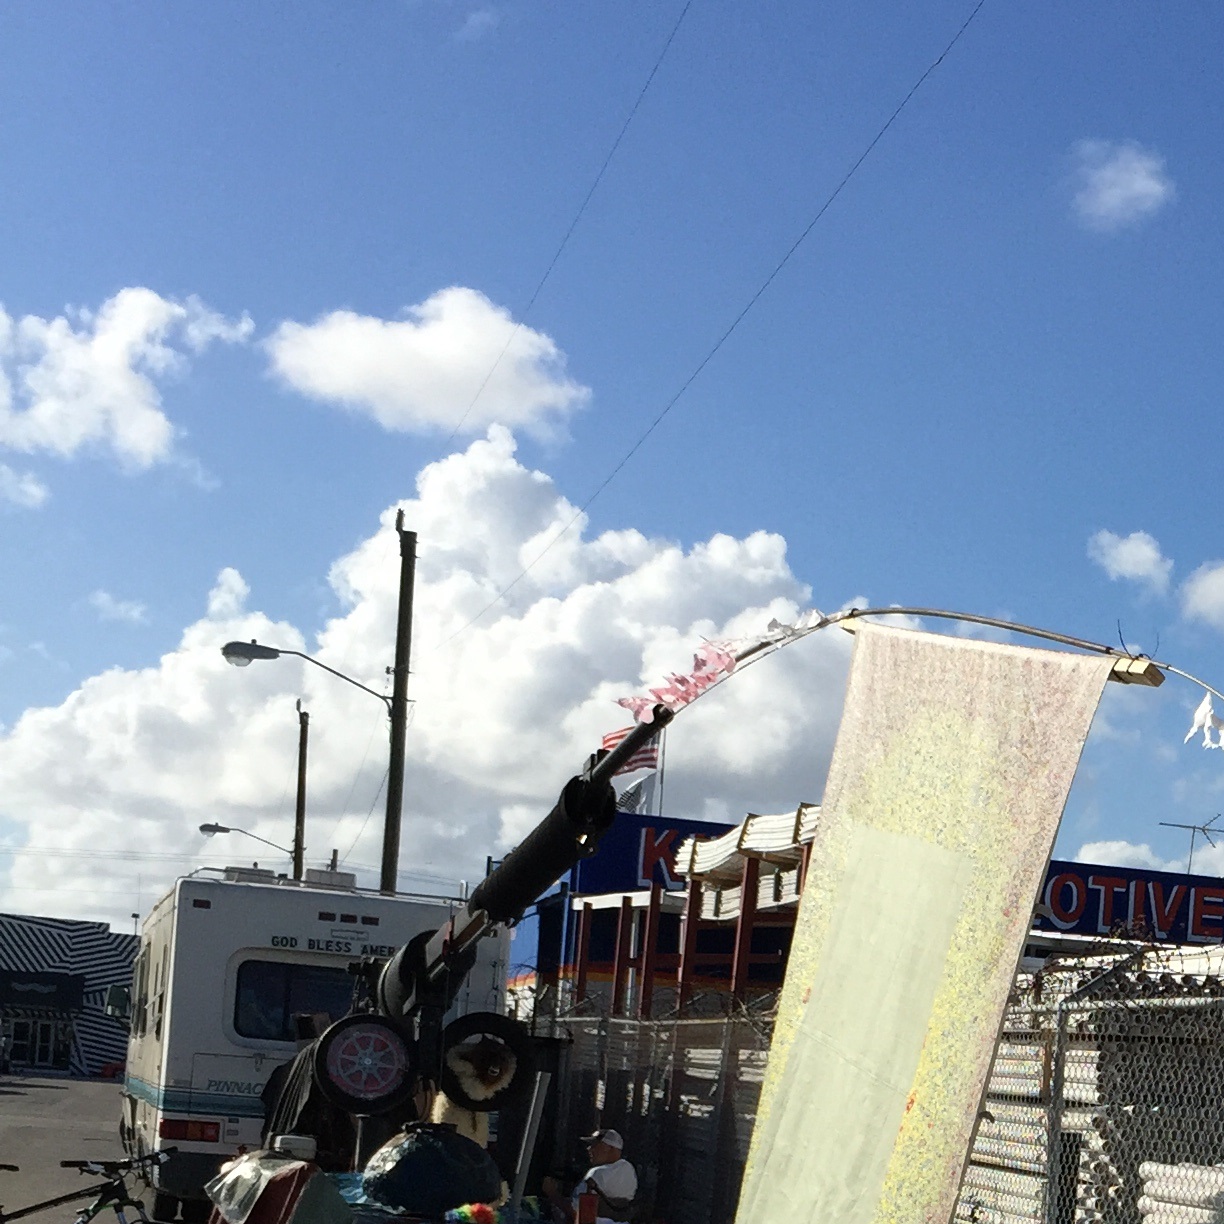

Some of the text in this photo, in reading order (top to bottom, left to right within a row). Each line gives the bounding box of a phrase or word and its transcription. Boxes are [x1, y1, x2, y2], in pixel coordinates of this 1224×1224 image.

[271, 935, 397, 957] GOD BLESS AMER
[207, 1079, 265, 1095] PINNAC
